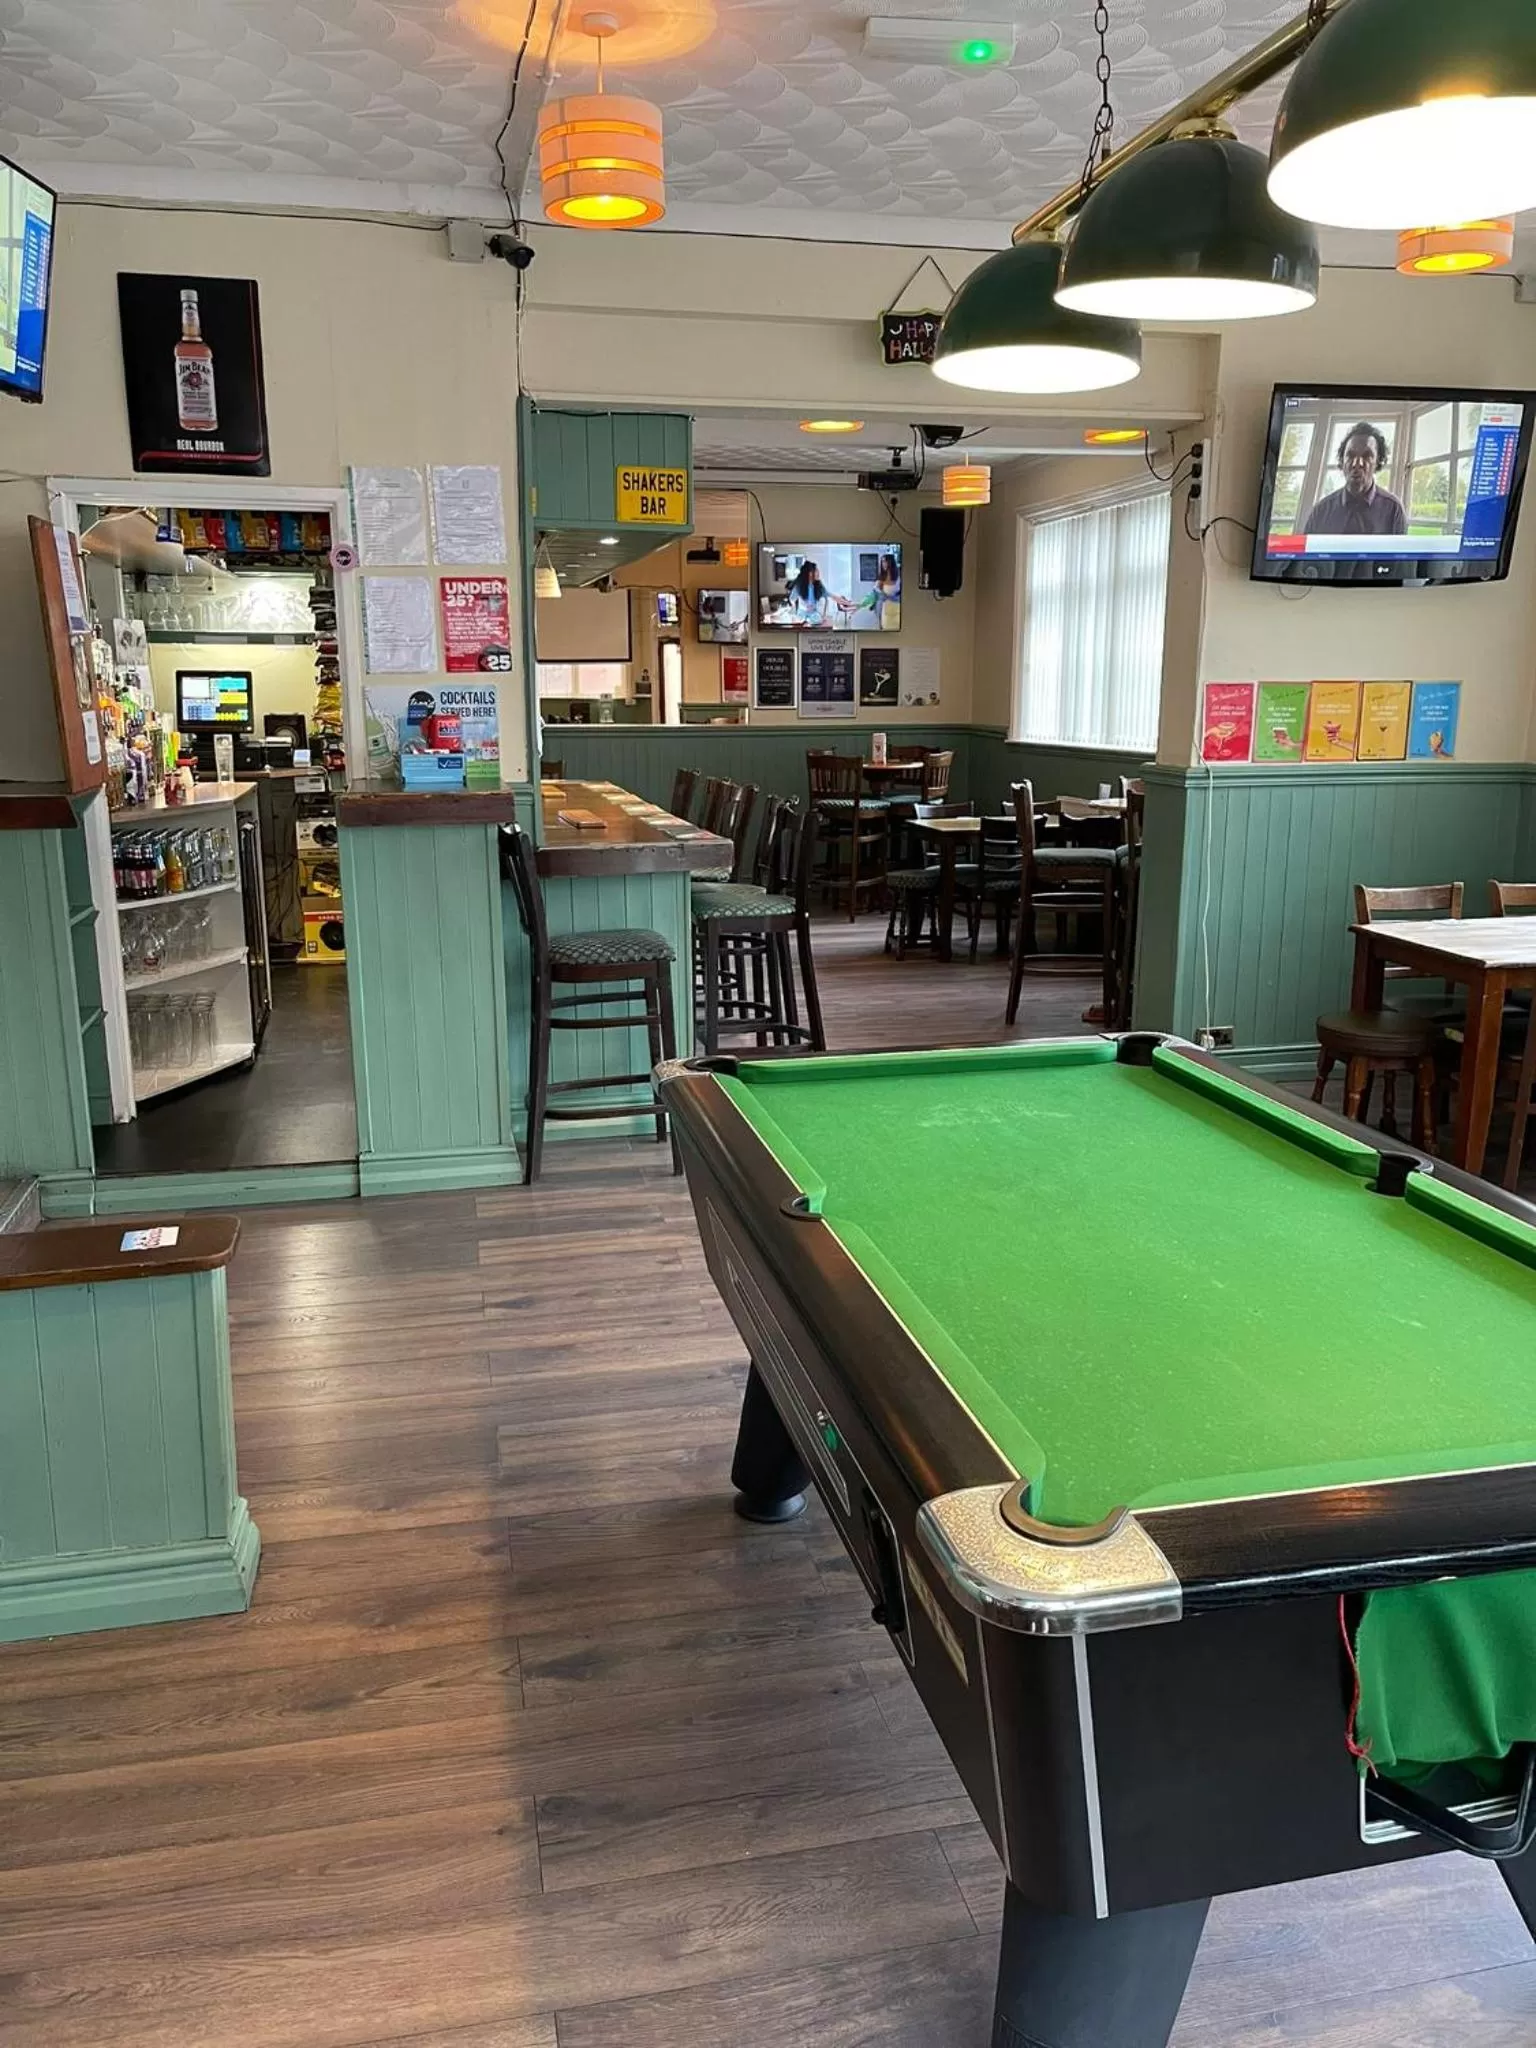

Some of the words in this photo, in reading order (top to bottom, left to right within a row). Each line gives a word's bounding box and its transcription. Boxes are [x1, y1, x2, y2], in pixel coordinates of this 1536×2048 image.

[622, 471, 684, 493] SHAKERS
[640, 495, 666, 515] BAR
[445, 582, 503, 595] UNDER
[446, 595, 475, 607] 25?
[487, 654, 511, 671] 25
[440, 691, 495, 705] COCKTAILS
[473, 706, 496, 718] HERE!
